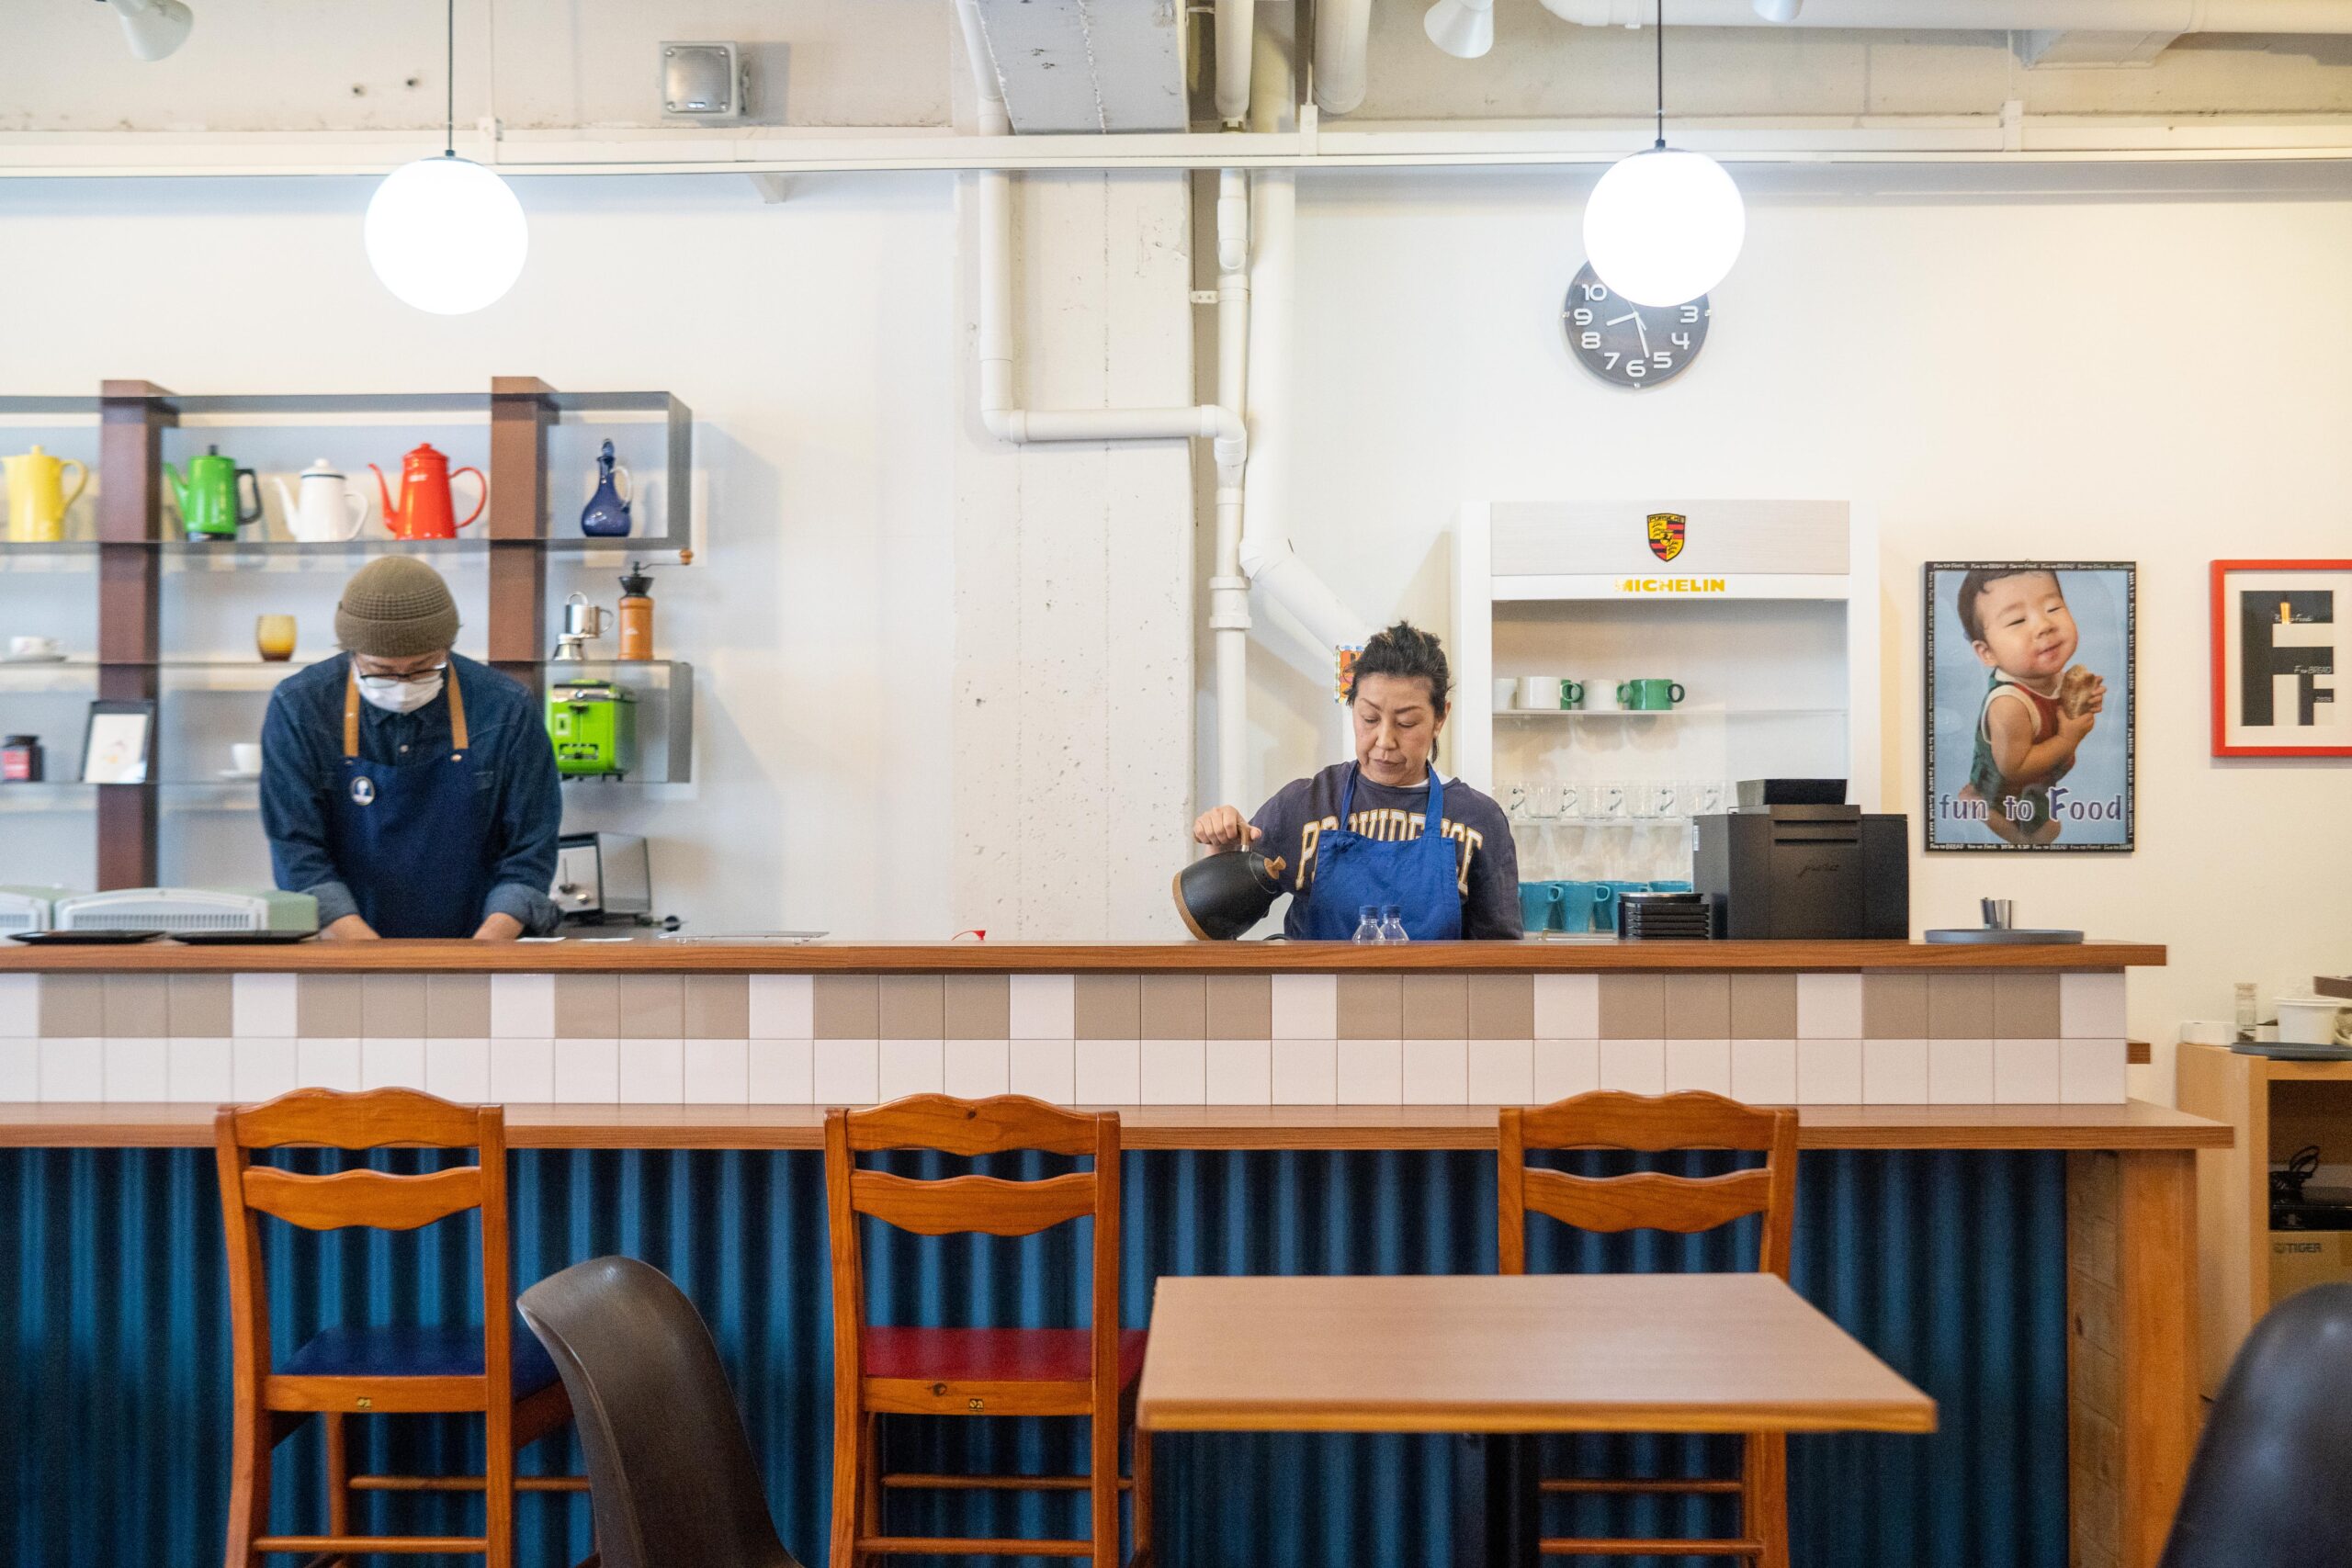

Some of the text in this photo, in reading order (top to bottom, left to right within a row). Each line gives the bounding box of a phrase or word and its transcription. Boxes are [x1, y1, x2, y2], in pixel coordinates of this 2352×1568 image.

[1581, 283, 1608, 301] 10
[1573, 308, 1593, 326] 9
[1679, 305, 1699, 323] 3
[1580, 331, 1601, 350] 8
[1670, 332, 1690, 351] 4
[1603, 352, 1621, 370] 7
[1625, 359, 1646, 378] 6
[1653, 351, 1673, 369] 5
[1939, 786, 2122, 821] fun to Food
[2285, 1242, 2323, 1254] TIGER
